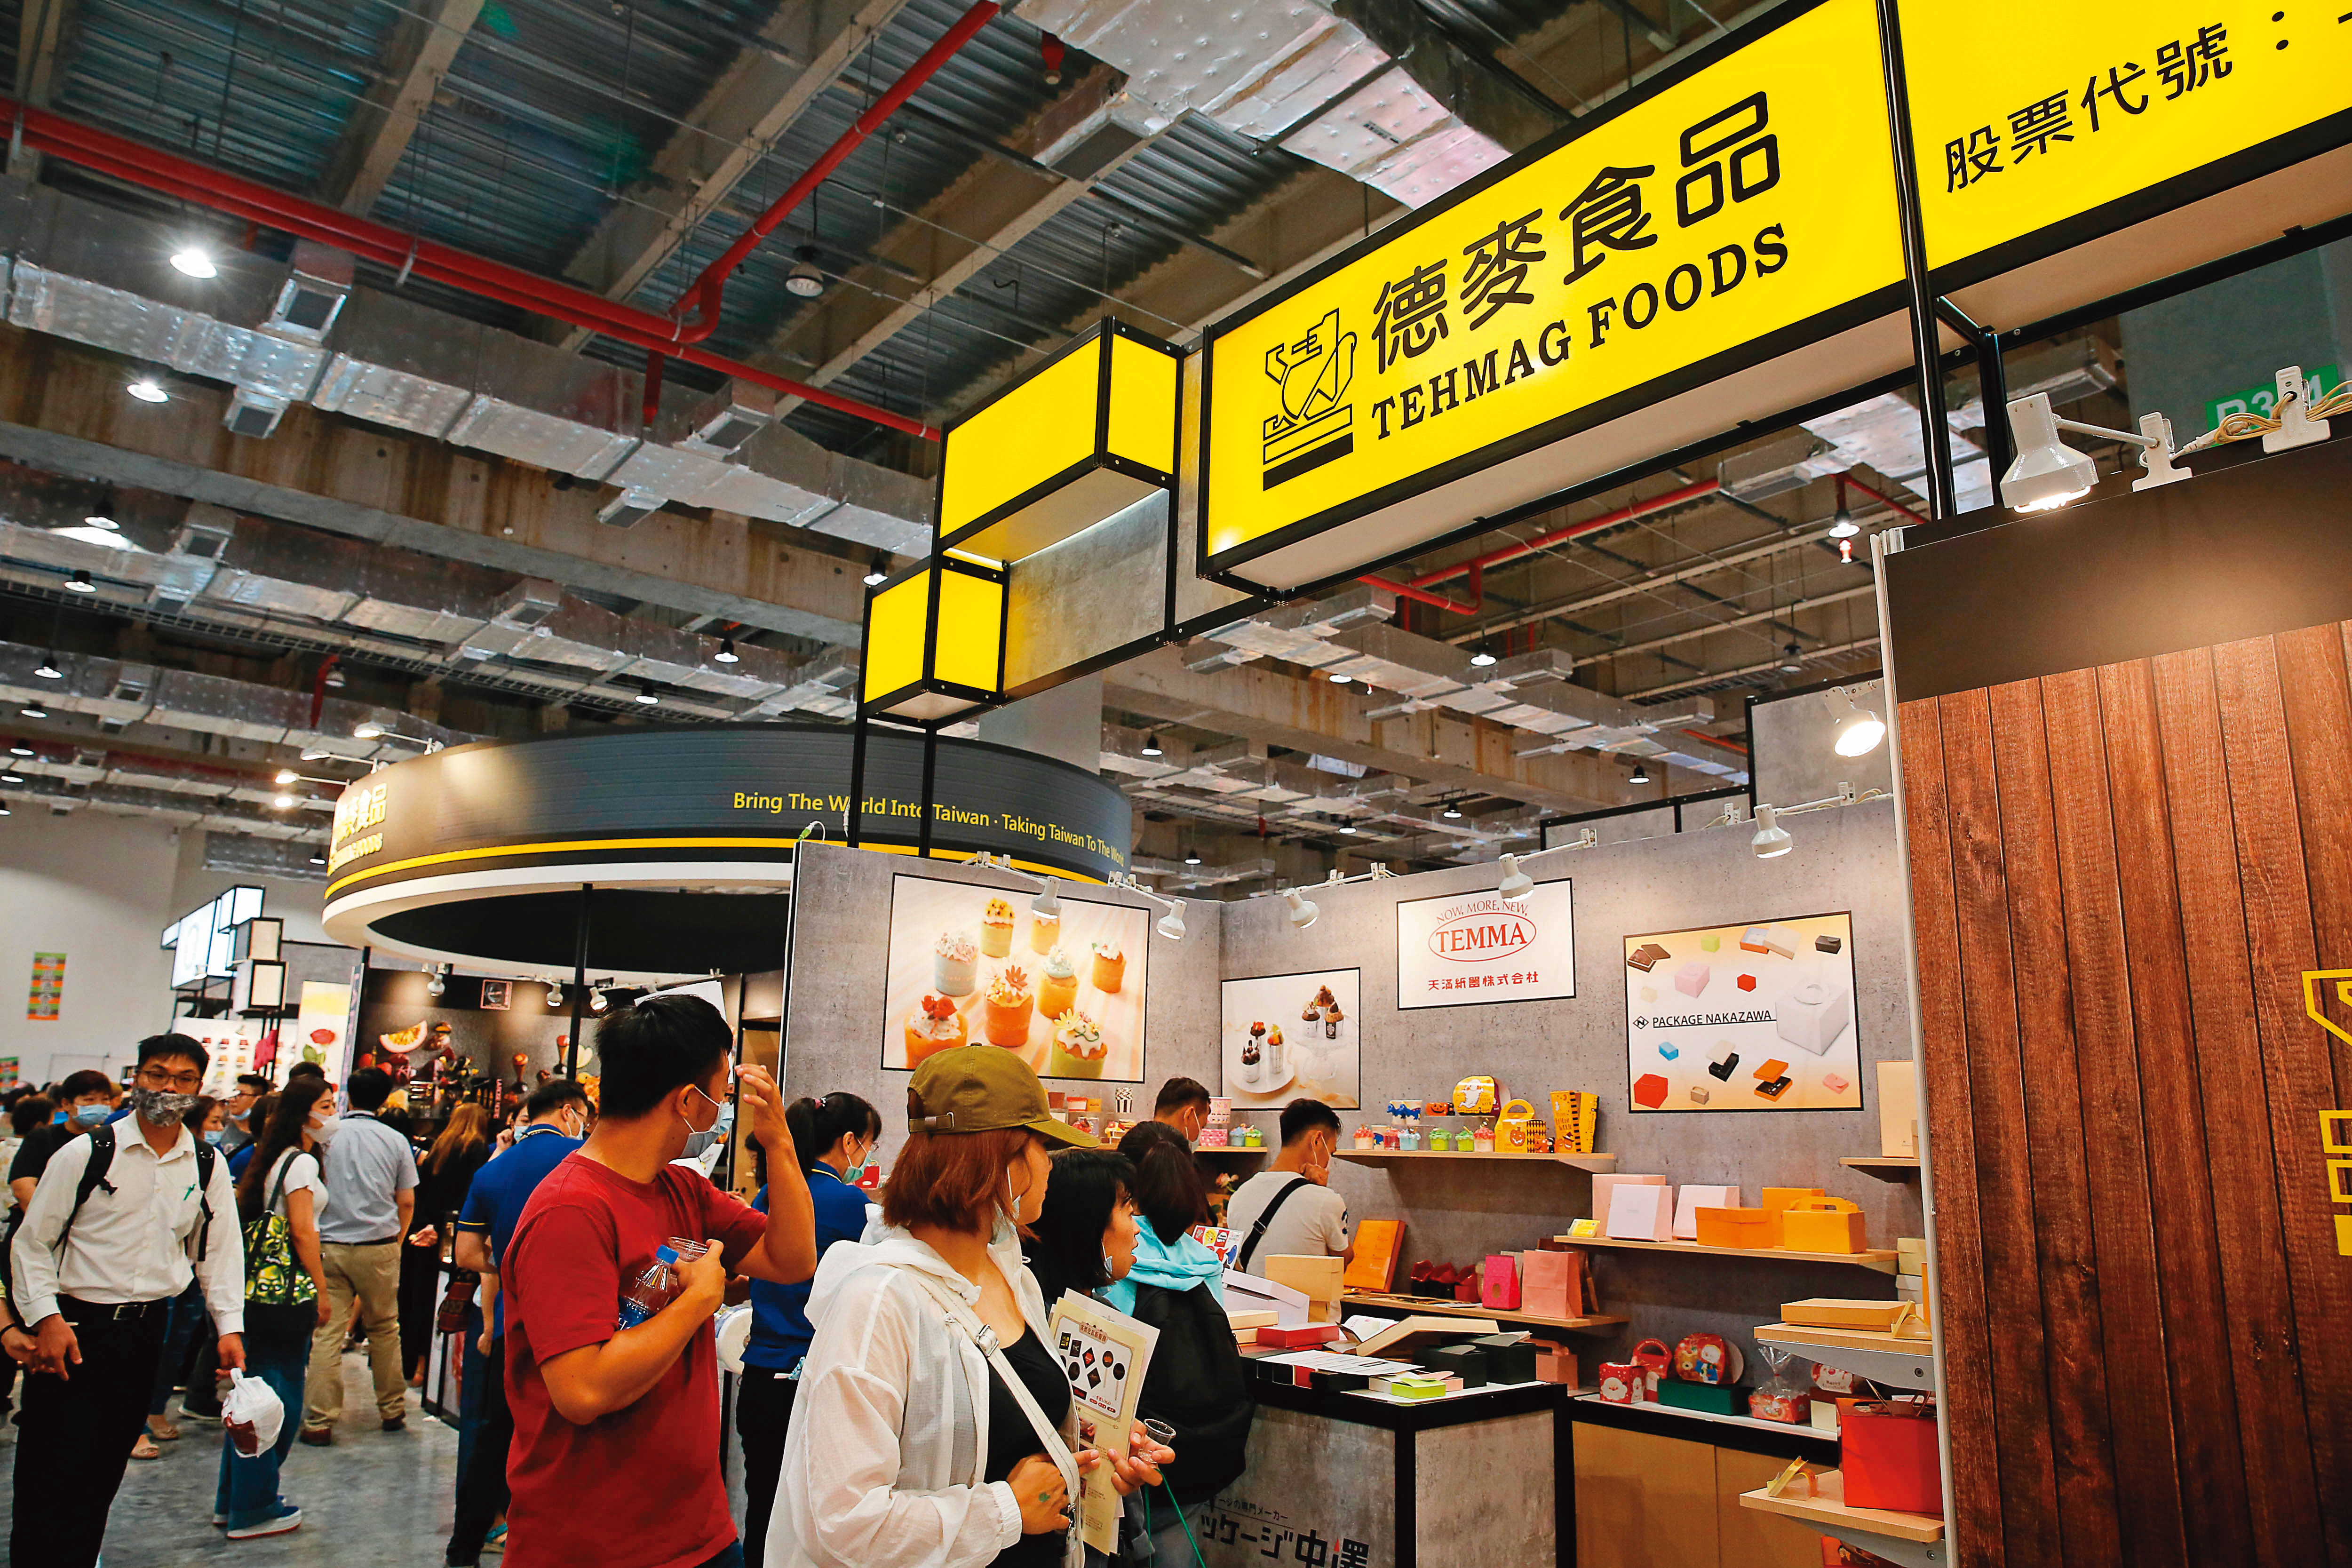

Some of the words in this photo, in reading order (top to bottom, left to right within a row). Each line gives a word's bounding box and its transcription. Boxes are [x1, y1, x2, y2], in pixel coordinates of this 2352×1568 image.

[1946, 11, 2352, 193] 股票代號：
[1371, 91, 1780, 374] 德麥食品
[1371, 320, 1571, 440] TEHMAG
[1587, 223, 1788, 349] FOODS
[734, 792, 783, 814] Bring
[788, 793, 823, 811] The
[828, 795, 886, 814] Wrld
[932, 804, 989, 827] Taiwan
[1001, 813, 1046, 841] Taking
[1048, 824, 1084, 847] Taiwan
[1086, 835, 1097, 852] To
[1097, 839, 1111, 858] The
[1435, 922, 1528, 953] TEMMA
[1436, 906, 1464, 924] NOW,
[1467, 899, 1500, 913] MORE,
[1502, 900, 1529, 916] NEW,
[1653, 1014, 1703, 1027] PACKAGE
[1706, 1010, 1772, 1024] NAKAZAWA
